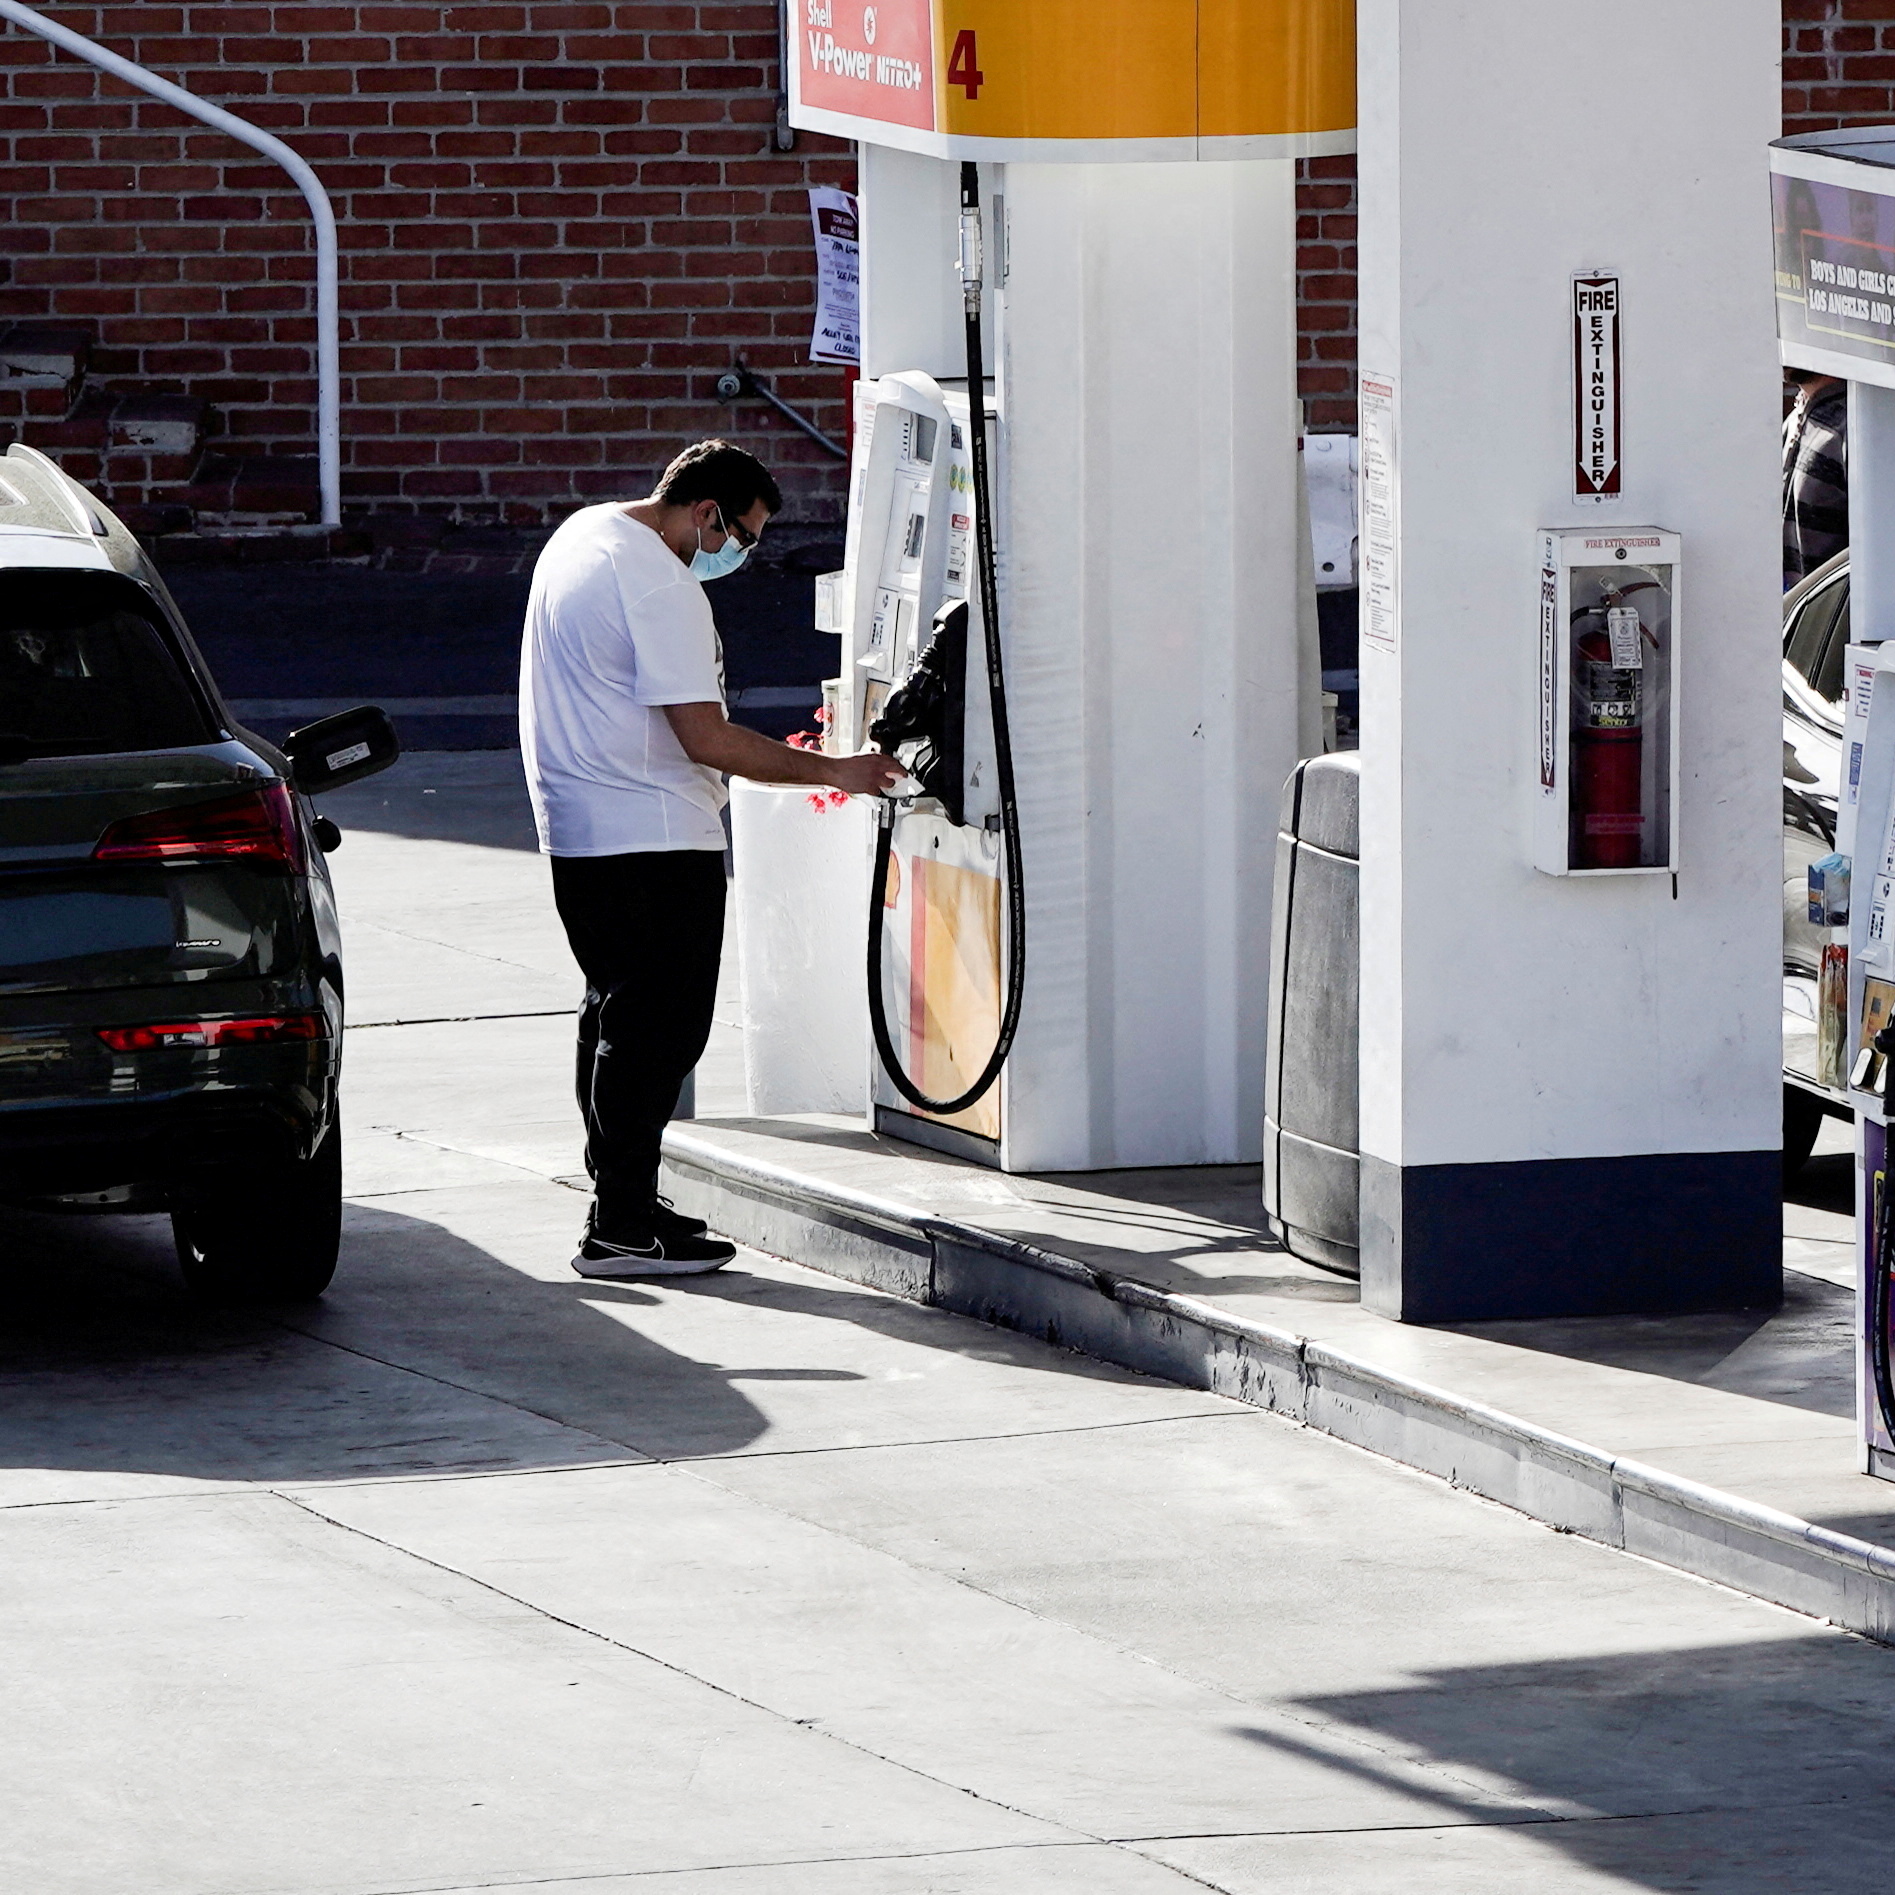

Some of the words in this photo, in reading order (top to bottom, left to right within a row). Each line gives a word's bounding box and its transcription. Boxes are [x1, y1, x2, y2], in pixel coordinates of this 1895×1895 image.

[807, 30, 872, 81] V-Power
[947, 29, 984, 100] 4
[1810, 258, 1835, 286] BOYS
[1836, 266, 1857, 289] AND
[1858, 272, 1886, 294] GIRLS
[1578, 290, 1615, 312] FIRE
[1808, 288, 1827, 312] LOS
[1827, 294, 1870, 321] ANGELES
[1870, 302, 1892, 325] AND
[1590, 315, 1605, 482] EXTINGUISHER
[1584, 539, 1604, 549] FIRE
[1604, 537, 1661, 549] EXTINGUISHER
